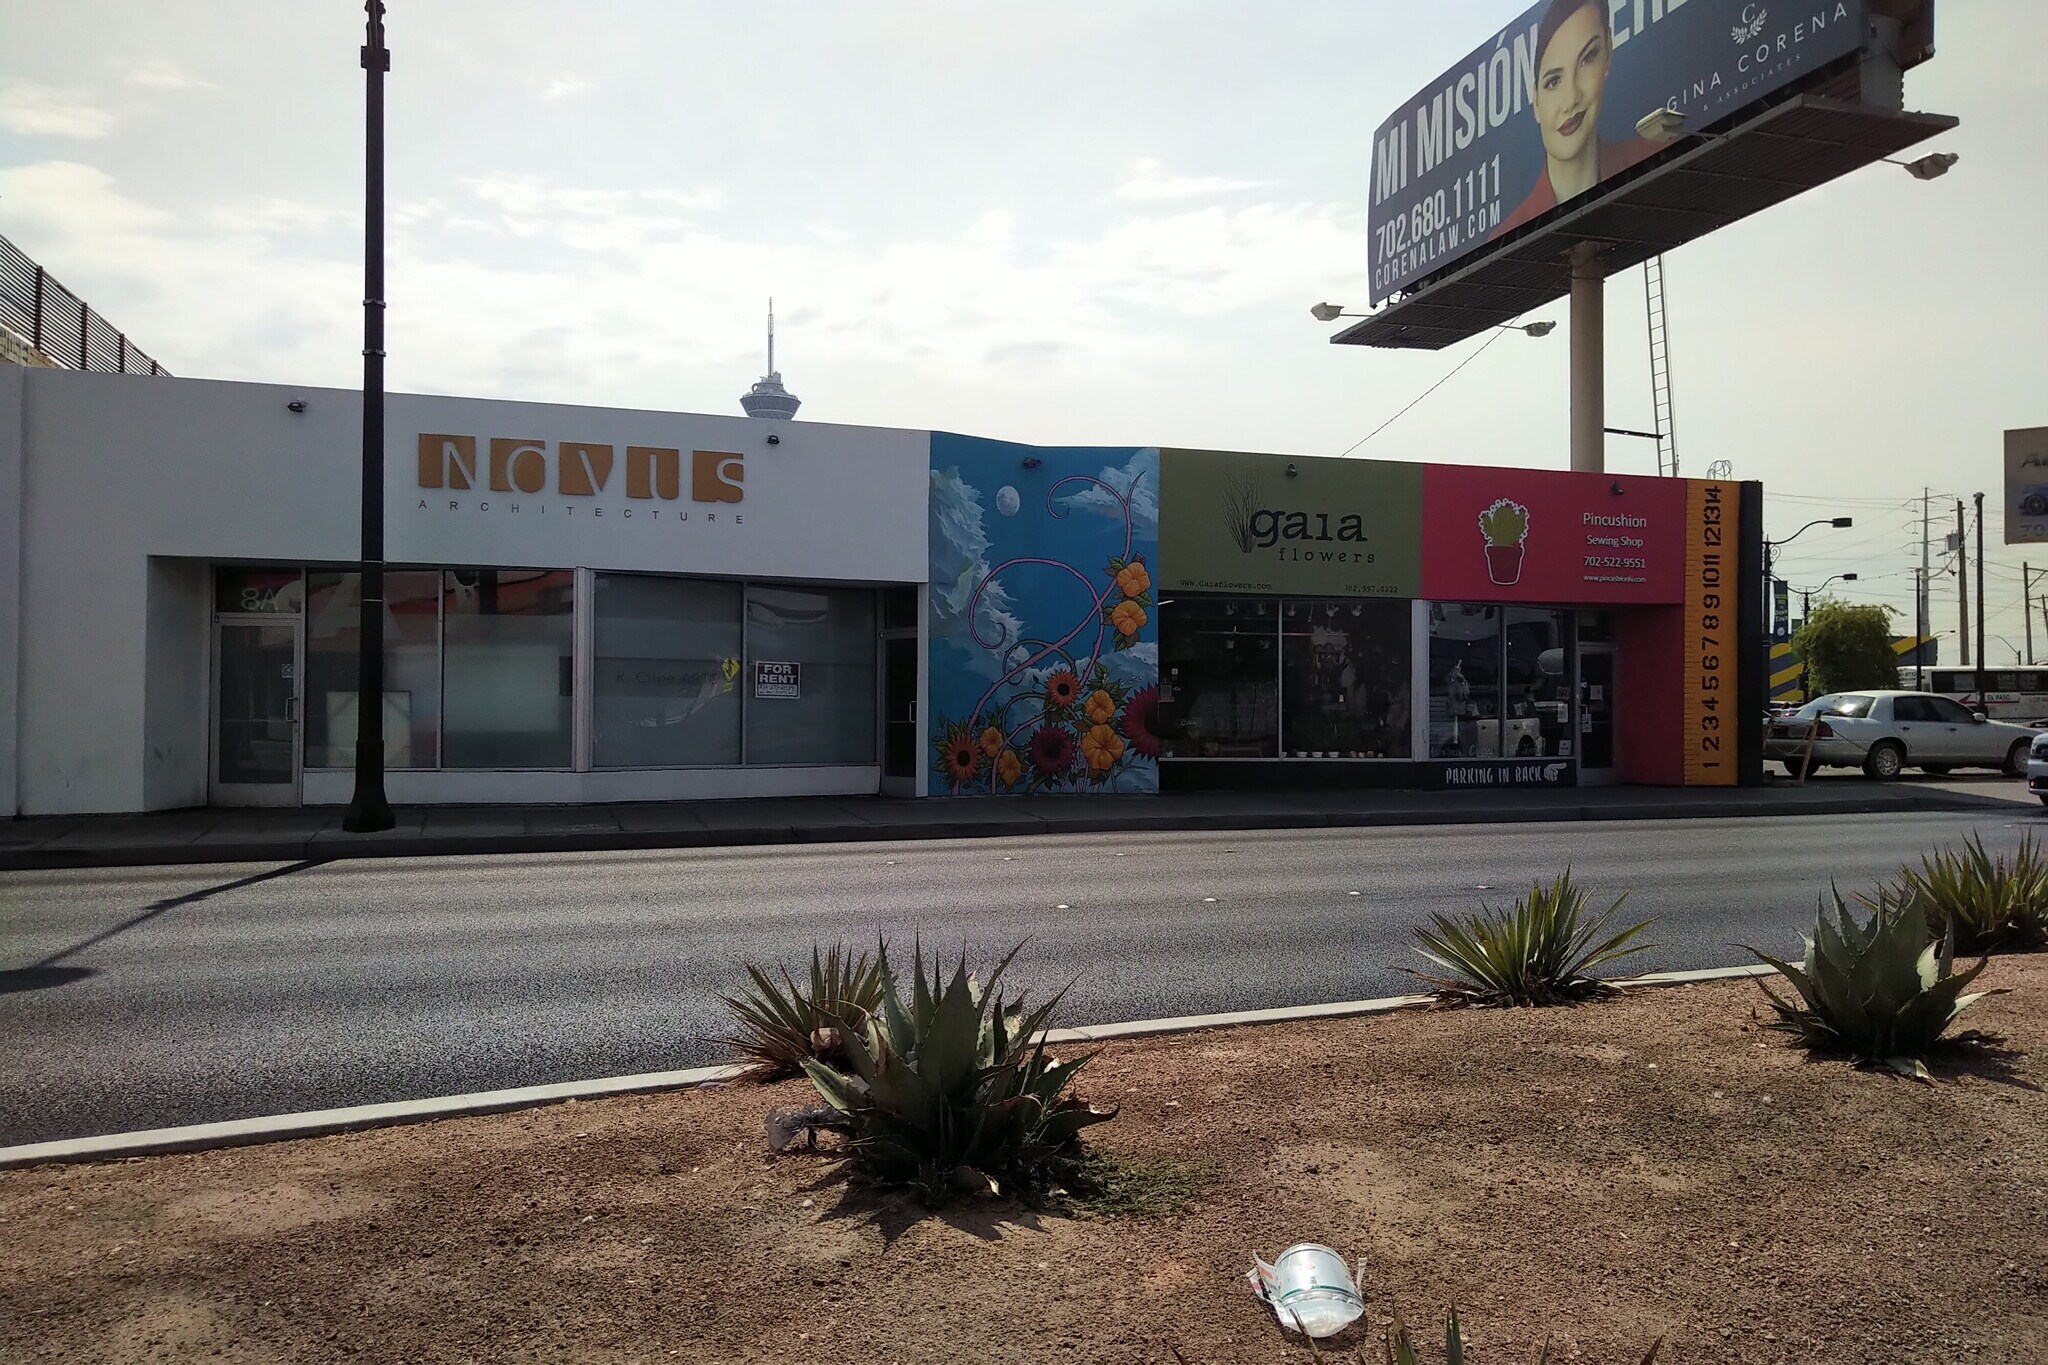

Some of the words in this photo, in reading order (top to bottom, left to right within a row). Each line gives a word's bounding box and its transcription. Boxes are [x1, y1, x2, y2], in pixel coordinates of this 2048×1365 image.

[1666, 71, 1722, 112] GINA
[1738, 2, 1847, 73] CORENA
[1717, 54, 1802, 104] ASSOCIATES
[1375, 119, 1408, 207] MI
[1416, 23, 1539, 179] MISIÓN
[1375, 153, 1500, 265] 702.680.1111
[1375, 199, 1501, 290] CORENALAW.COM
[418, 433, 744, 504] NOVUS
[1704, 485, 1722, 505] 14
[418, 500, 744, 524] ARCHITECTURE
[1583, 512, 1647, 528] Pincushion
[1703, 506, 1721, 526] 13
[1249, 509, 1368, 548] gaia
[1587, 534, 1620, 547] Sewing
[1620, 536, 1644, 549] Shop
[1703, 527, 1722, 547] 12
[1279, 547, 1376, 563] flowers
[1583, 556, 1646, 569] 702-522-9551
[1703, 554, 1720, 566] 11
[1702, 568, 1720, 588] 10
[1344, 584, 1399, 594] 702.997.0222
[1702, 594, 1720, 609] 9
[1702, 615, 1719, 630] 8
[1702, 636, 1719, 650] 7
[763, 664, 792, 674] FOR
[1702, 656, 1719, 670] 6
[759, 674, 797, 684] RENT
[1702, 676, 1719, 690] 5
[1702, 697, 1719, 711] 4
[1702, 716, 1719, 731] 3
[1702, 736, 1720, 751] 2
[1446, 767, 1494, 785] PARKING
[1498, 767, 1510, 784] IN
[1515, 766, 1543, 783] BACK
